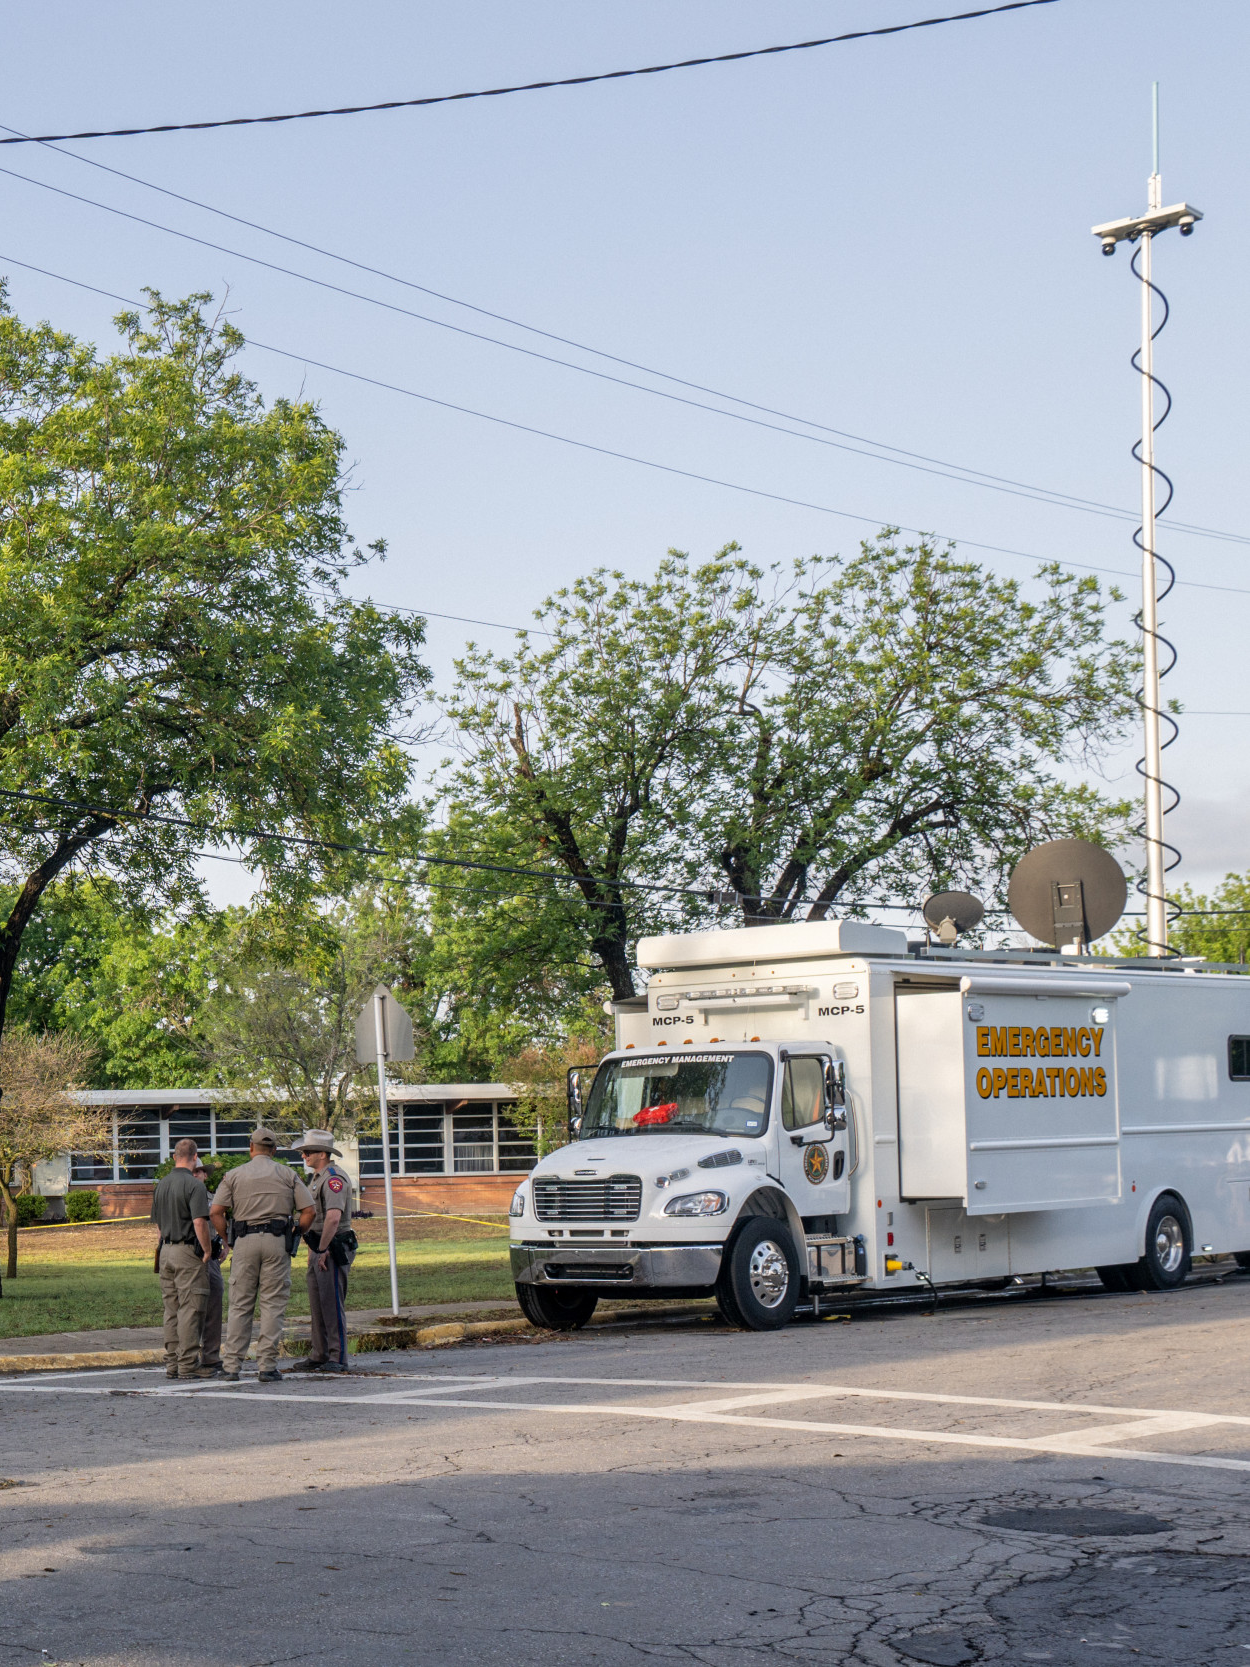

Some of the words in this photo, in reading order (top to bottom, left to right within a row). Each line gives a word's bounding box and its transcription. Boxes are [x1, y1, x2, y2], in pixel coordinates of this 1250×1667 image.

[818, 1005, 865, 1017] MCP-5
[652, 1015, 694, 1026] MCP-5
[976, 1026, 1104, 1057] EMERGENCY
[621, 1056, 670, 1068] EMERGENCY
[671, 1054, 734, 1064] MANAGEMENT
[976, 1066, 1107, 1099] OPERATIONS
